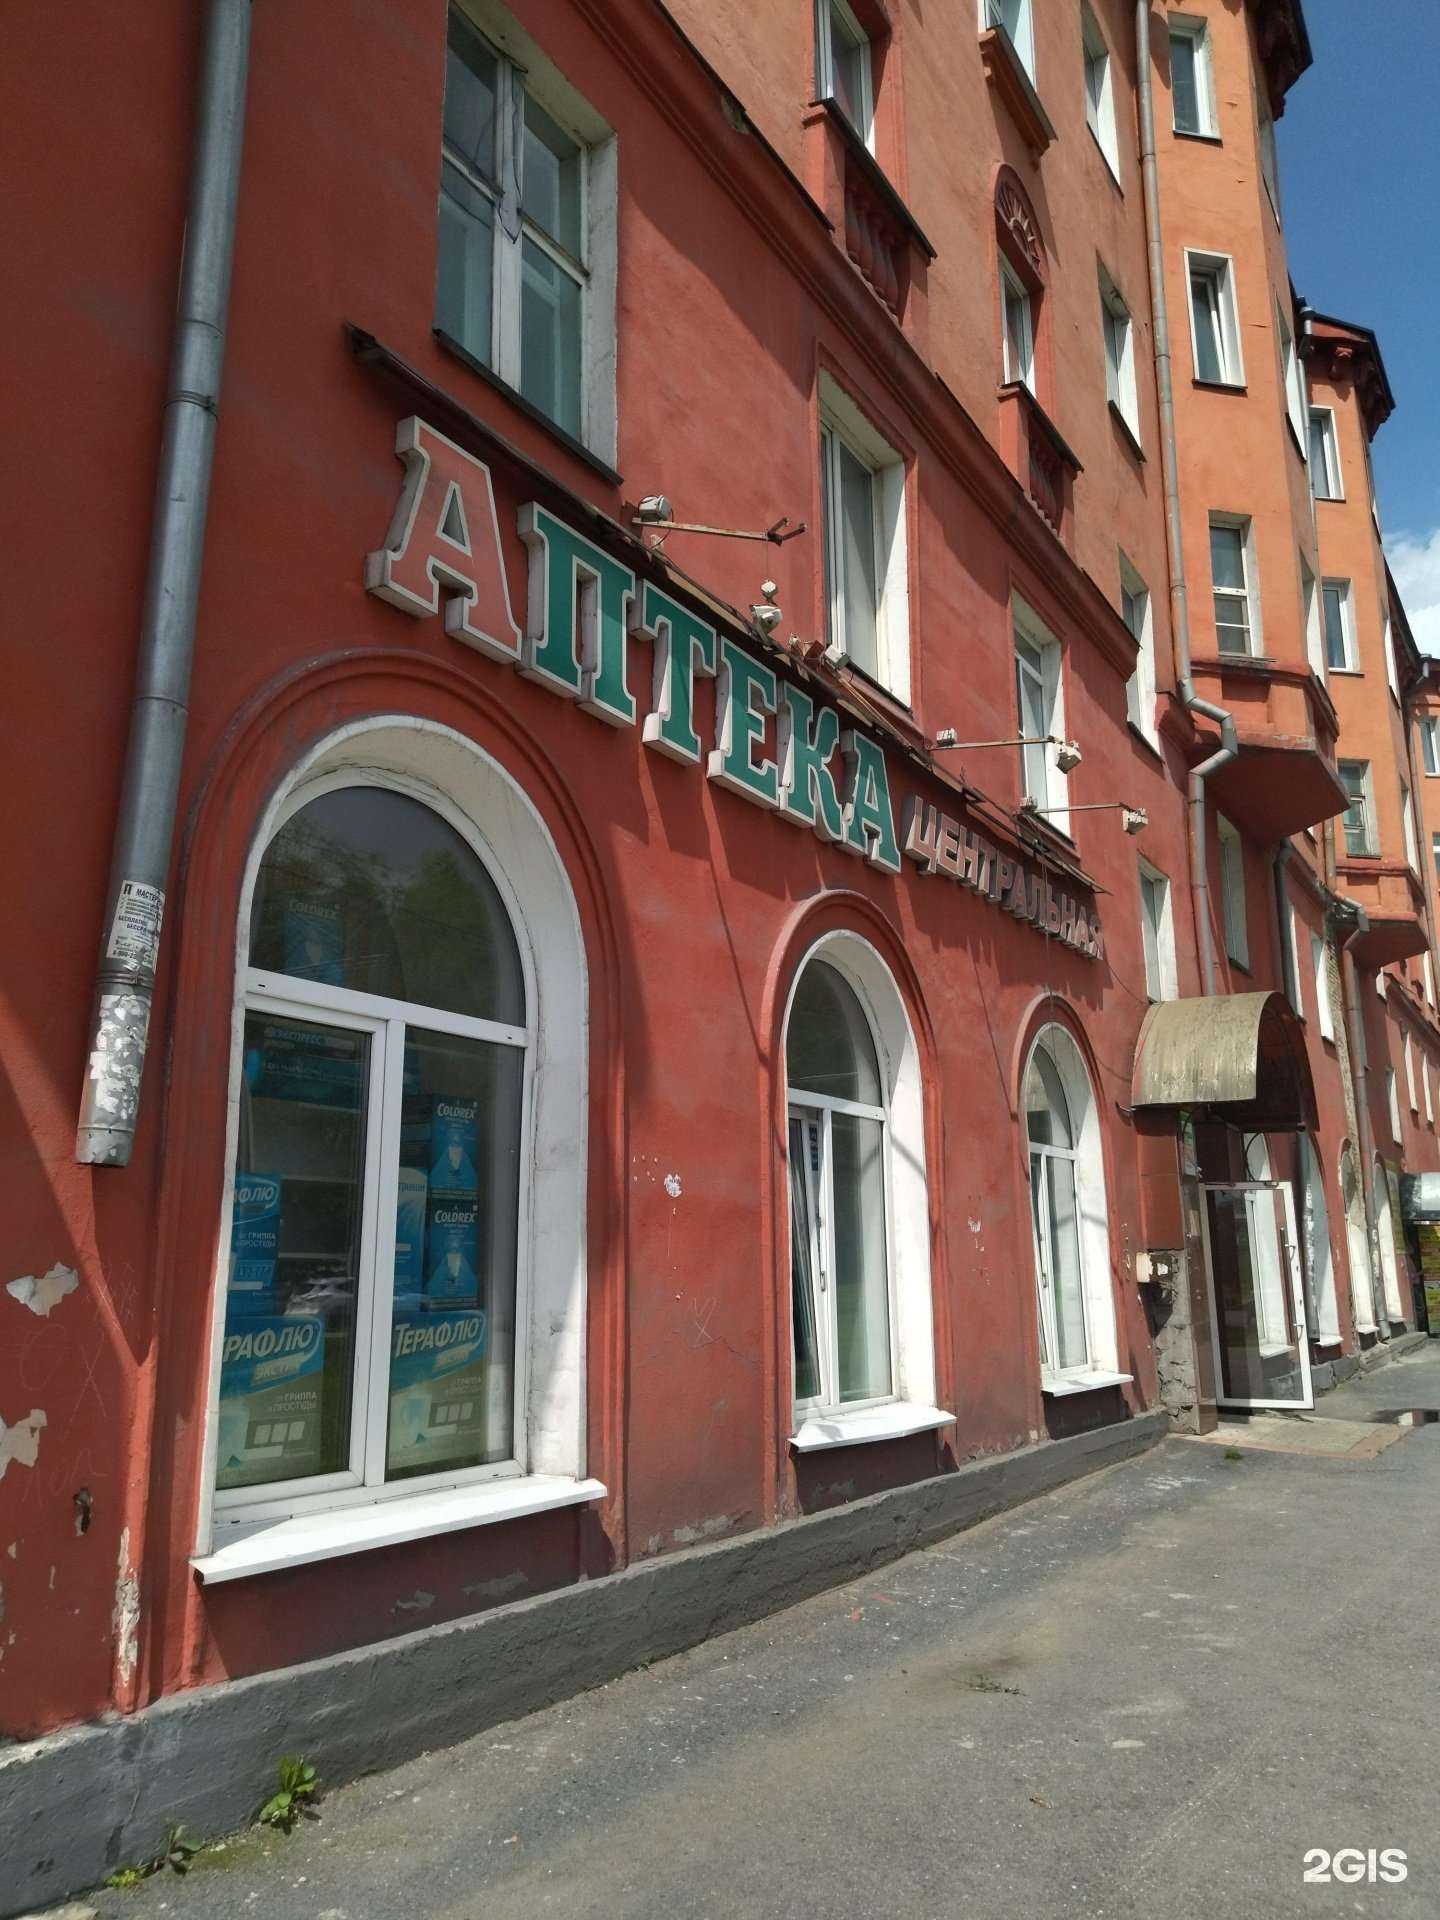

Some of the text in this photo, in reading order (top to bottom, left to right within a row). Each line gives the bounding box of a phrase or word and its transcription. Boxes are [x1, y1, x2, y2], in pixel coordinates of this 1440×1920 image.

[366, 415, 902, 875] АПТЕКА
[903, 794, 1104, 961] ЦЕНТРАЛЬНАЯ
[436, 1103, 476, 1119] COLDREX
[233, 1186, 275, 1204] ФЛЮ
[434, 1210, 476, 1224] COLDREX
[223, 1324, 313, 1362] РАФЛЮ
[394, 1317, 480, 1359] ТЕРАФЛЮ
